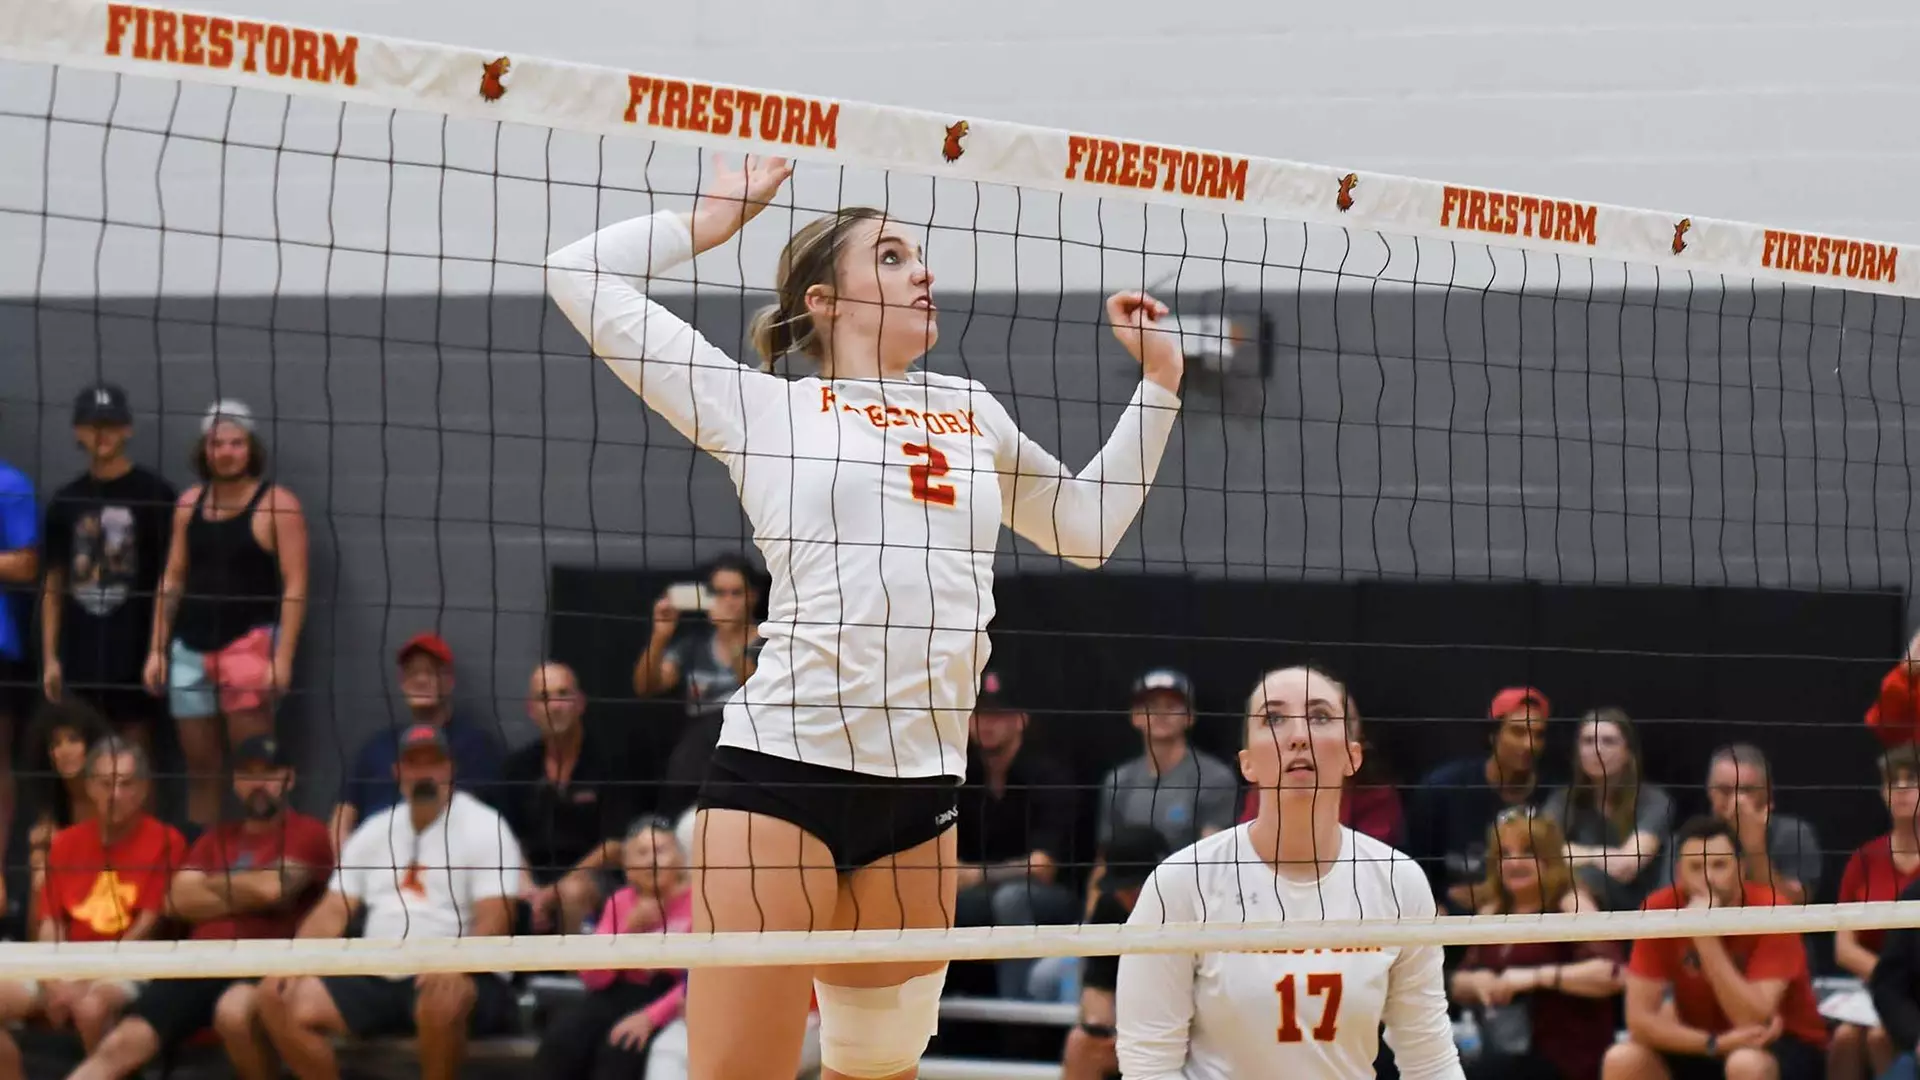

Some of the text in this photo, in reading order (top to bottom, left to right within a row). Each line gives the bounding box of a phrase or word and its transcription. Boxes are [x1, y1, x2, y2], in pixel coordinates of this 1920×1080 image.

[105, 4, 358, 87] FIRESTORM
[624, 75, 840, 150] FIRESTORM
[1065, 135, 1249, 201] FIRESTORM
[1440, 186, 1597, 245] FIRESTORM
[1761, 230, 1898, 283] FIRESTORM
[902, 441, 956, 507] 2
[1274, 972, 1343, 1043] 17
